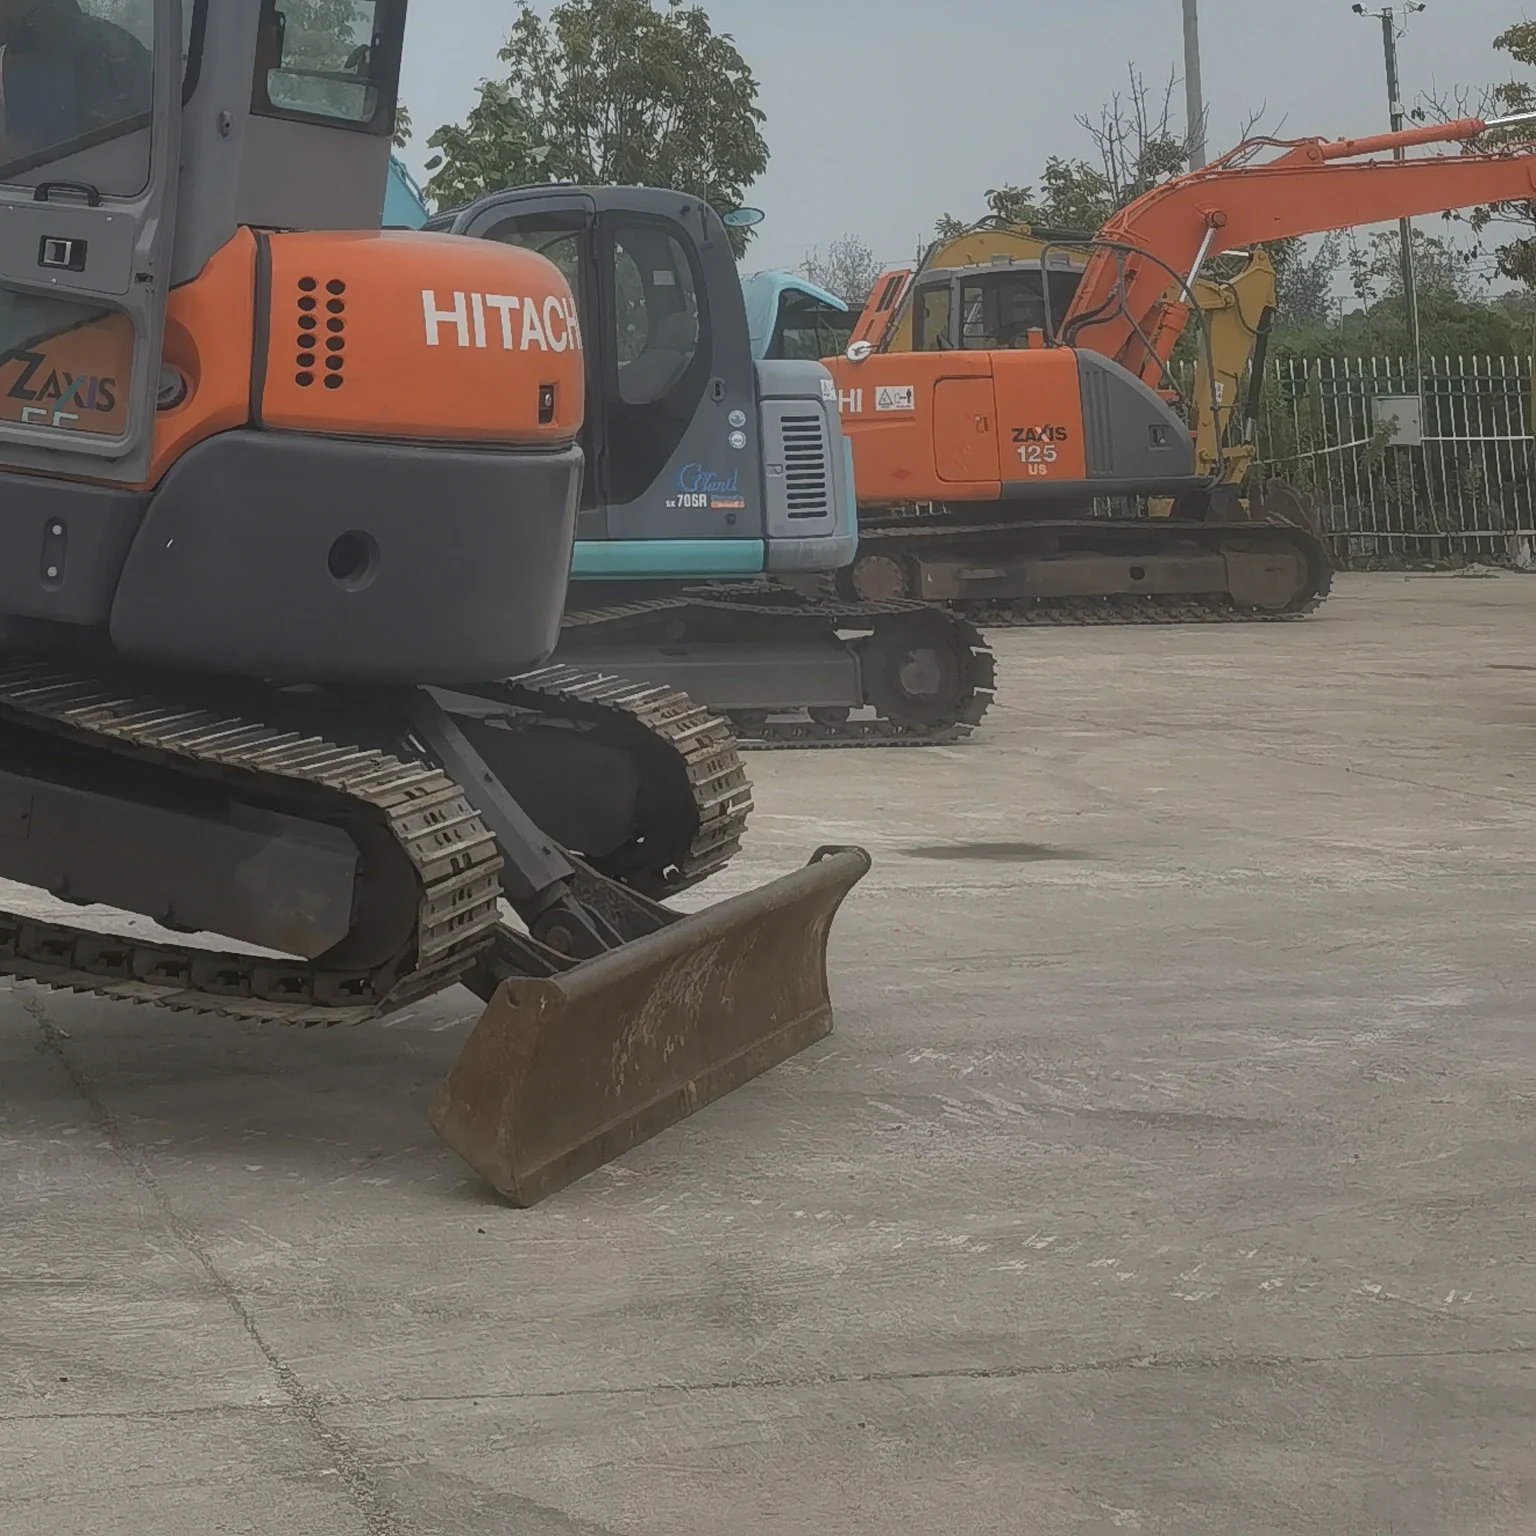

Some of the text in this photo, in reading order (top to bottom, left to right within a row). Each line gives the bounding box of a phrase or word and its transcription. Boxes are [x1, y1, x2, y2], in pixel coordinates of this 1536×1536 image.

[421, 289, 583, 353] HITACH
[6, 351, 116, 413] ZAXIS
[1011, 425, 1068, 443] ZAXIS
[1017, 444, 1057, 463] 125
[1028, 464, 1048, 475] US
